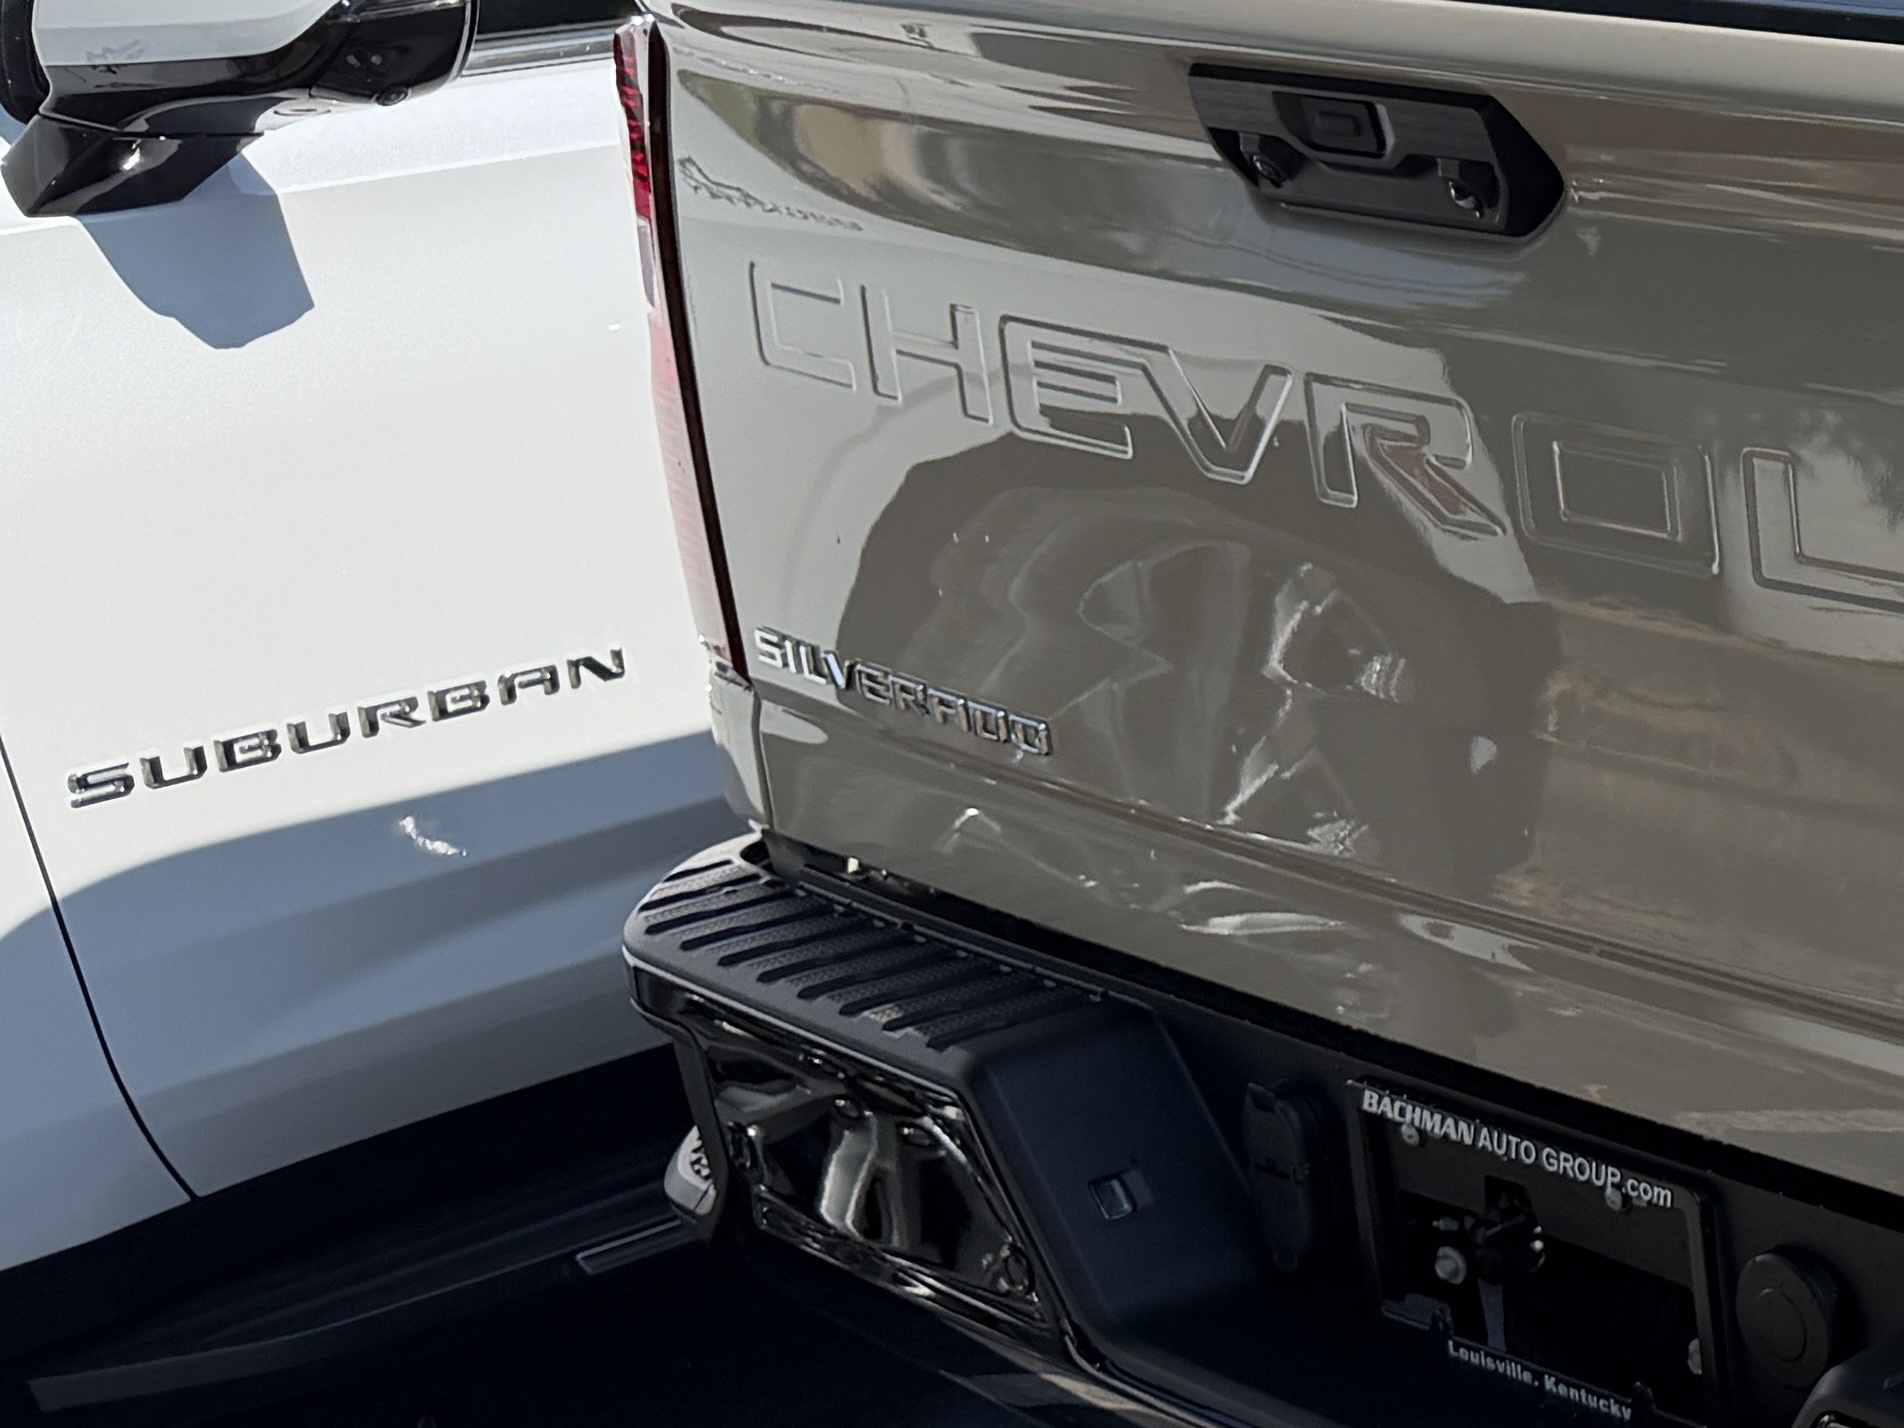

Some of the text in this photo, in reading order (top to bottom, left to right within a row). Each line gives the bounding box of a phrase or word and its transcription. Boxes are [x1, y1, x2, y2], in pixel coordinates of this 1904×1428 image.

[66, 643, 626, 809] SUBURBAN
[753, 625, 1053, 757] SILVERADO
[1362, 1088, 1674, 1209] BACHMAN AUTO GROUP.com
[1544, 1373, 1633, 1422] Kentucky
